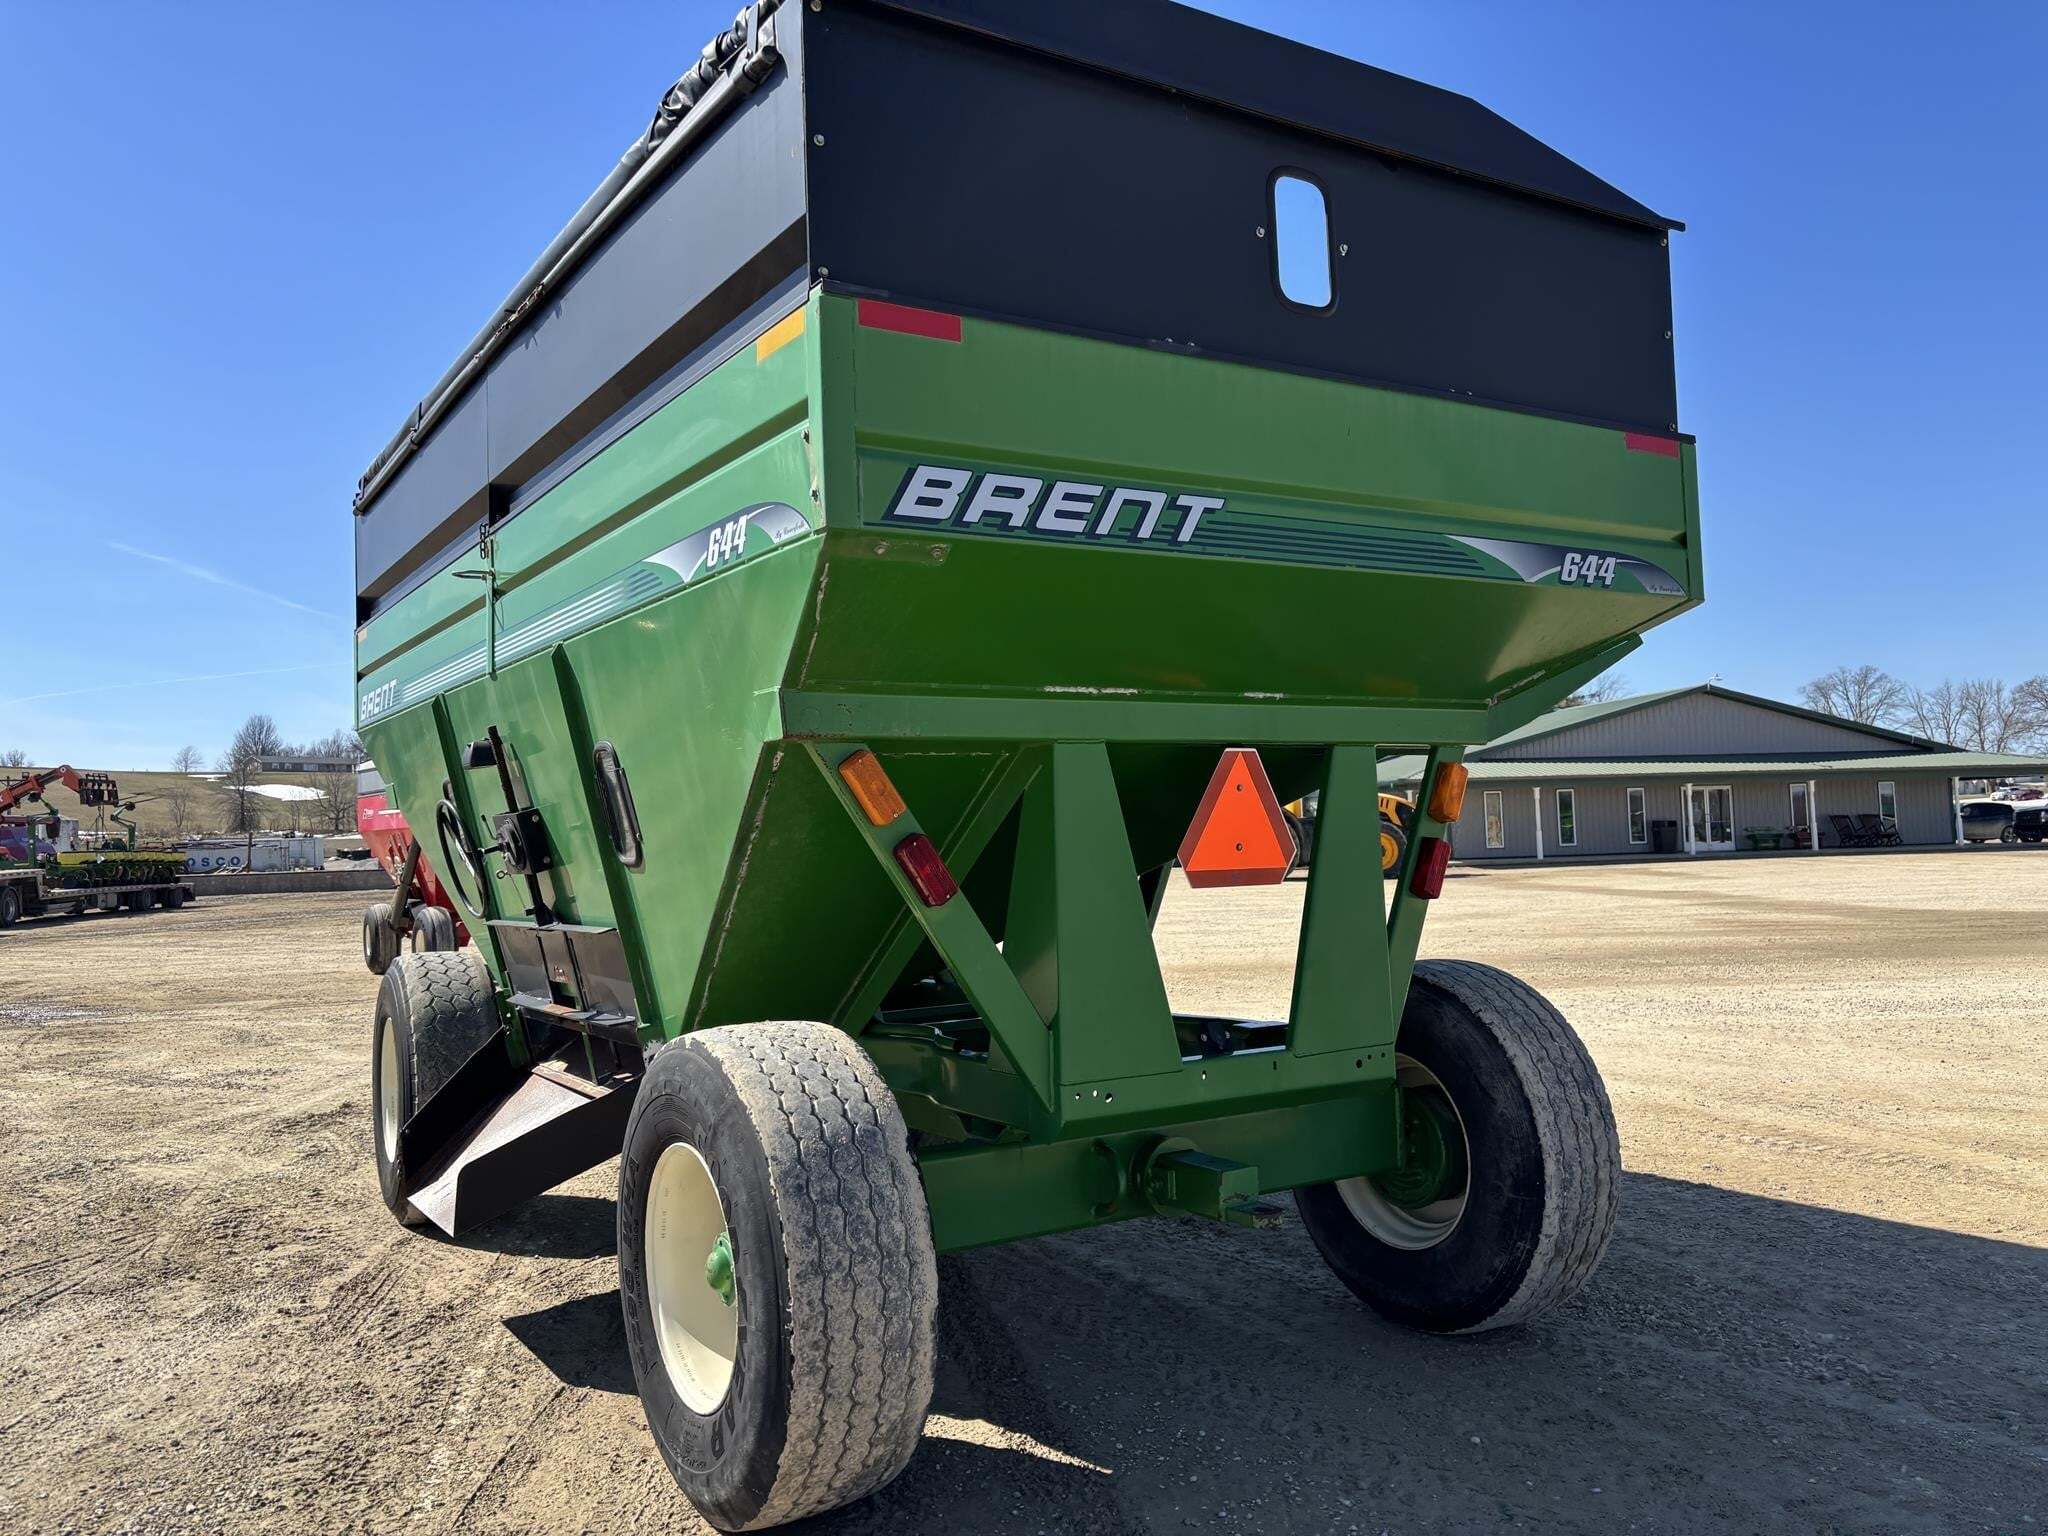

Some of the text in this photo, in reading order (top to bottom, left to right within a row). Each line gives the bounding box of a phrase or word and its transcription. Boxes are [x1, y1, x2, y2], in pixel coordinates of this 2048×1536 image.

[892, 464, 1225, 543] BRENT
[706, 514, 748, 568] 644
[1561, 553, 1615, 585] 644
[360, 679, 398, 720] BRENT
